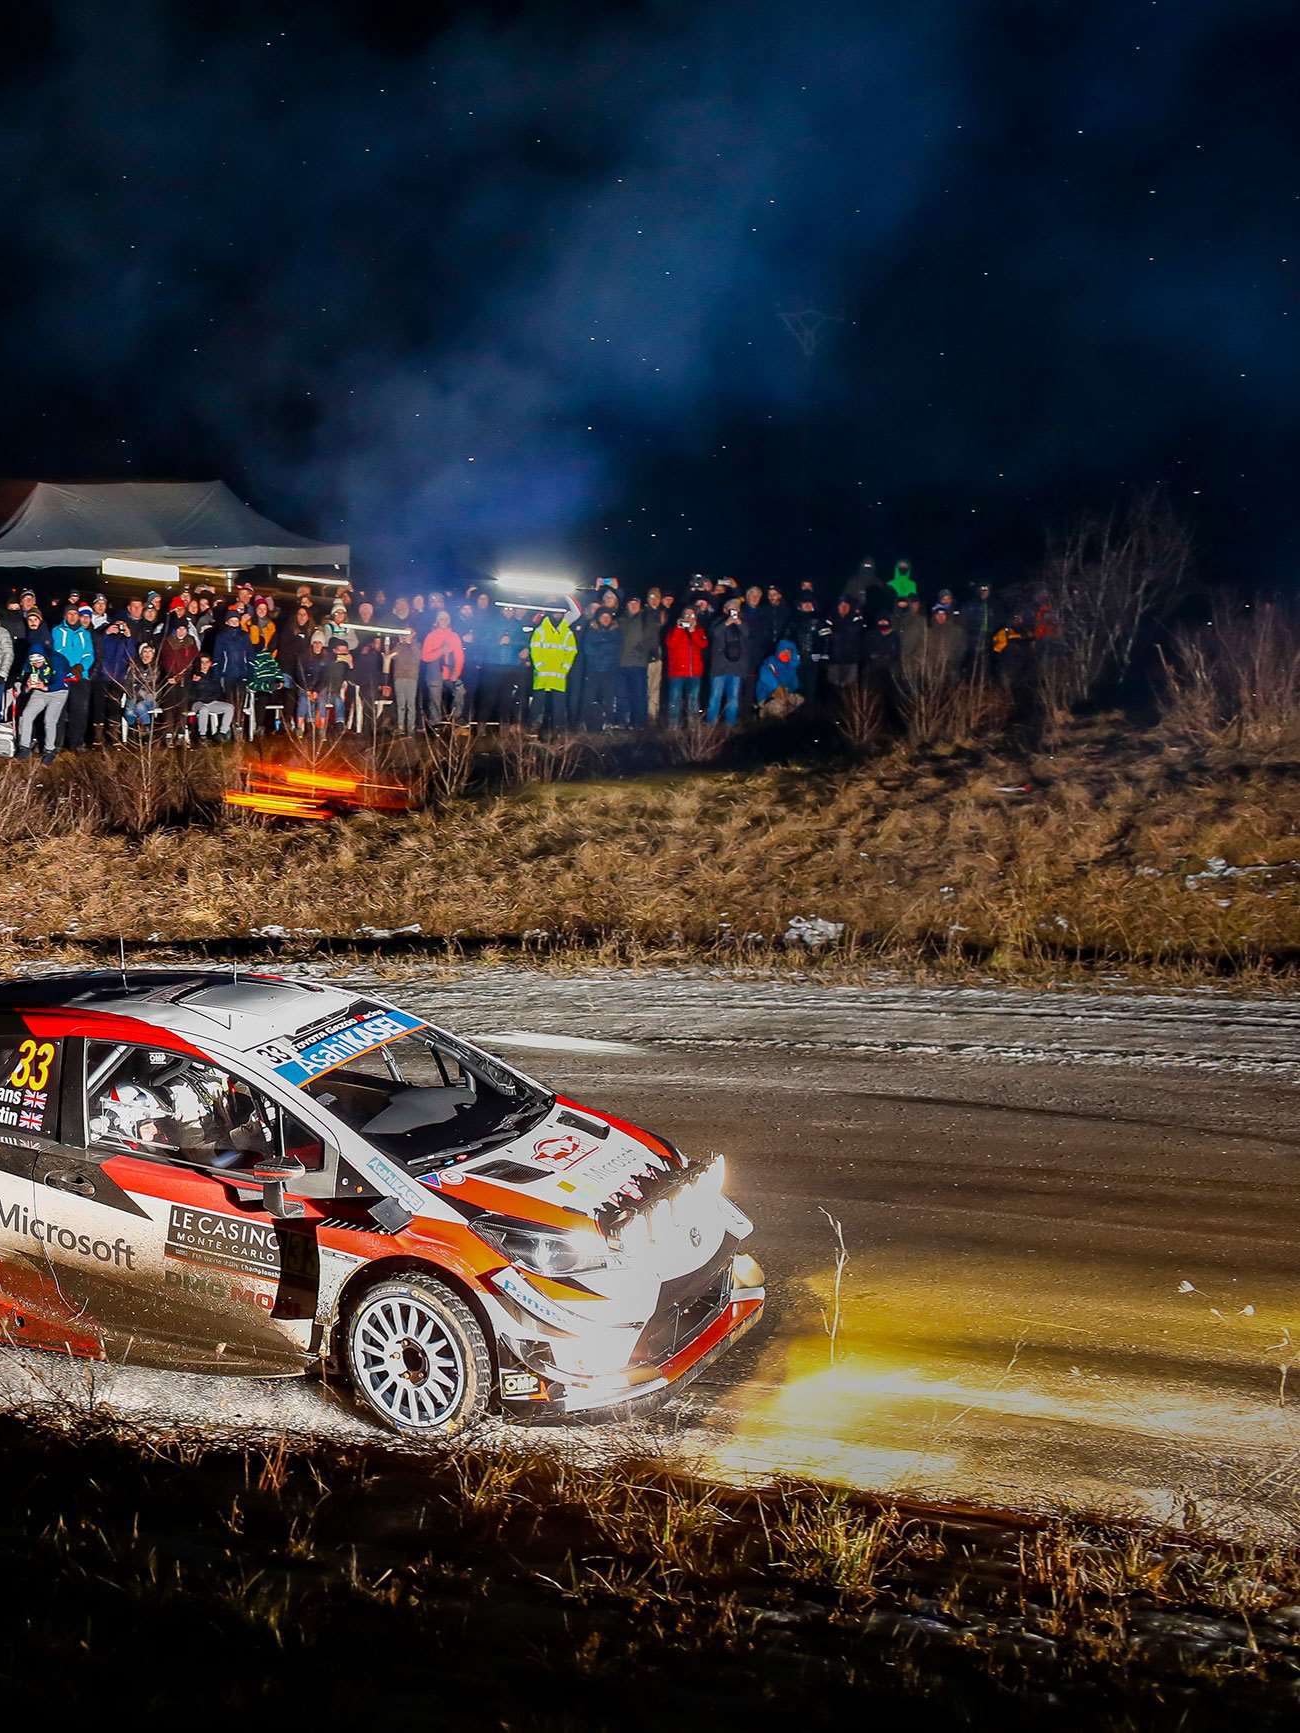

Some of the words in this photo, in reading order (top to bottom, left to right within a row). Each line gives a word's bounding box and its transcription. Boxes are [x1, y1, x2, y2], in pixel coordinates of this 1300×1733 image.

[291, 1031, 328, 1052] TOYOTA
[256, 1045, 292, 1064] 33
[11, 1039, 55, 1091] 33
[172, 1209, 194, 1230] LE
[198, 1216, 280, 1250] CASINO
[240, 1264, 281, 1279] Championshi
[504, 1375, 538, 1391] OMP
